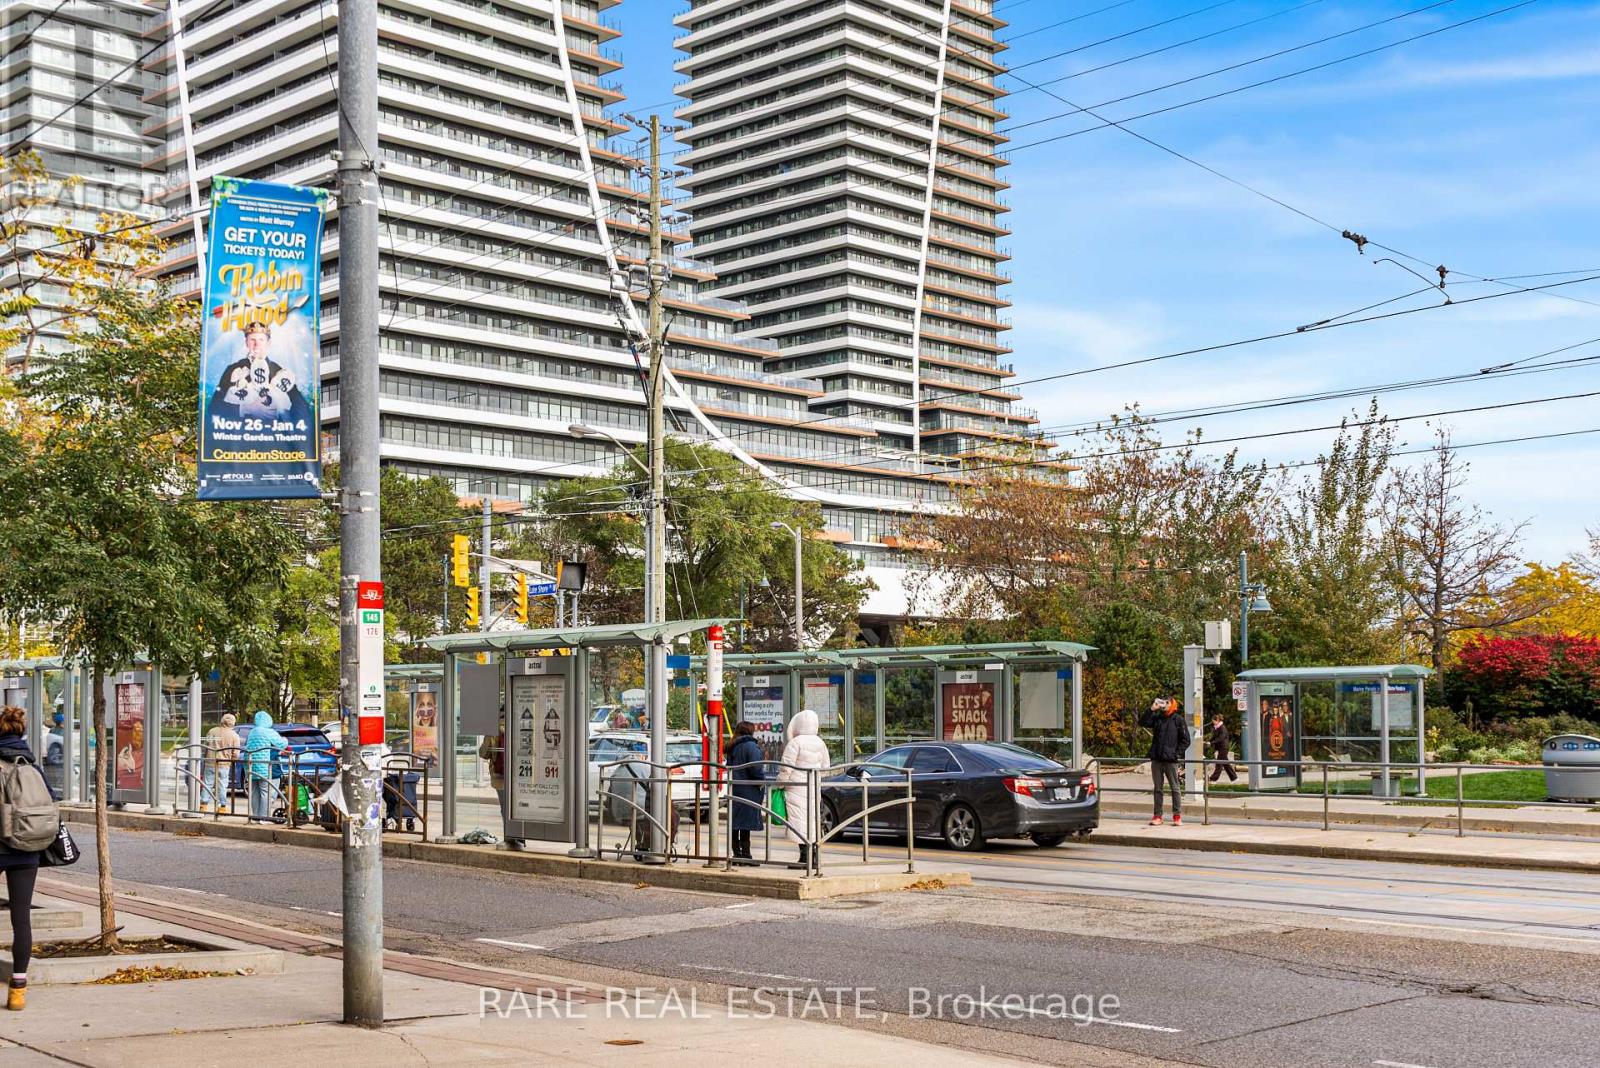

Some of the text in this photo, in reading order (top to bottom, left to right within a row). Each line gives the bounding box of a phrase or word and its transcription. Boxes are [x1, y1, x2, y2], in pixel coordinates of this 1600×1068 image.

[224, 226, 307, 249] GET YOUR
[223, 243, 305, 260] TICKETS TODAY!
[218, 259, 304, 300] Robin
[221, 292, 290, 334] Hood
[212, 415, 242, 430] Nov
[244, 418, 263, 431] 26
[271, 419, 294, 431] Jan
[296, 418, 308, 432] 4
[213, 432, 307, 442] Winter Garden Theatre
[213, 448, 306, 460] CanadianStage
[952, 695, 980, 709] LET'S
[952, 710, 988, 723] SNACK
[953, 724, 988, 742] AND
[519, 765, 533, 777] 211
[545, 766, 559, 778] 911
